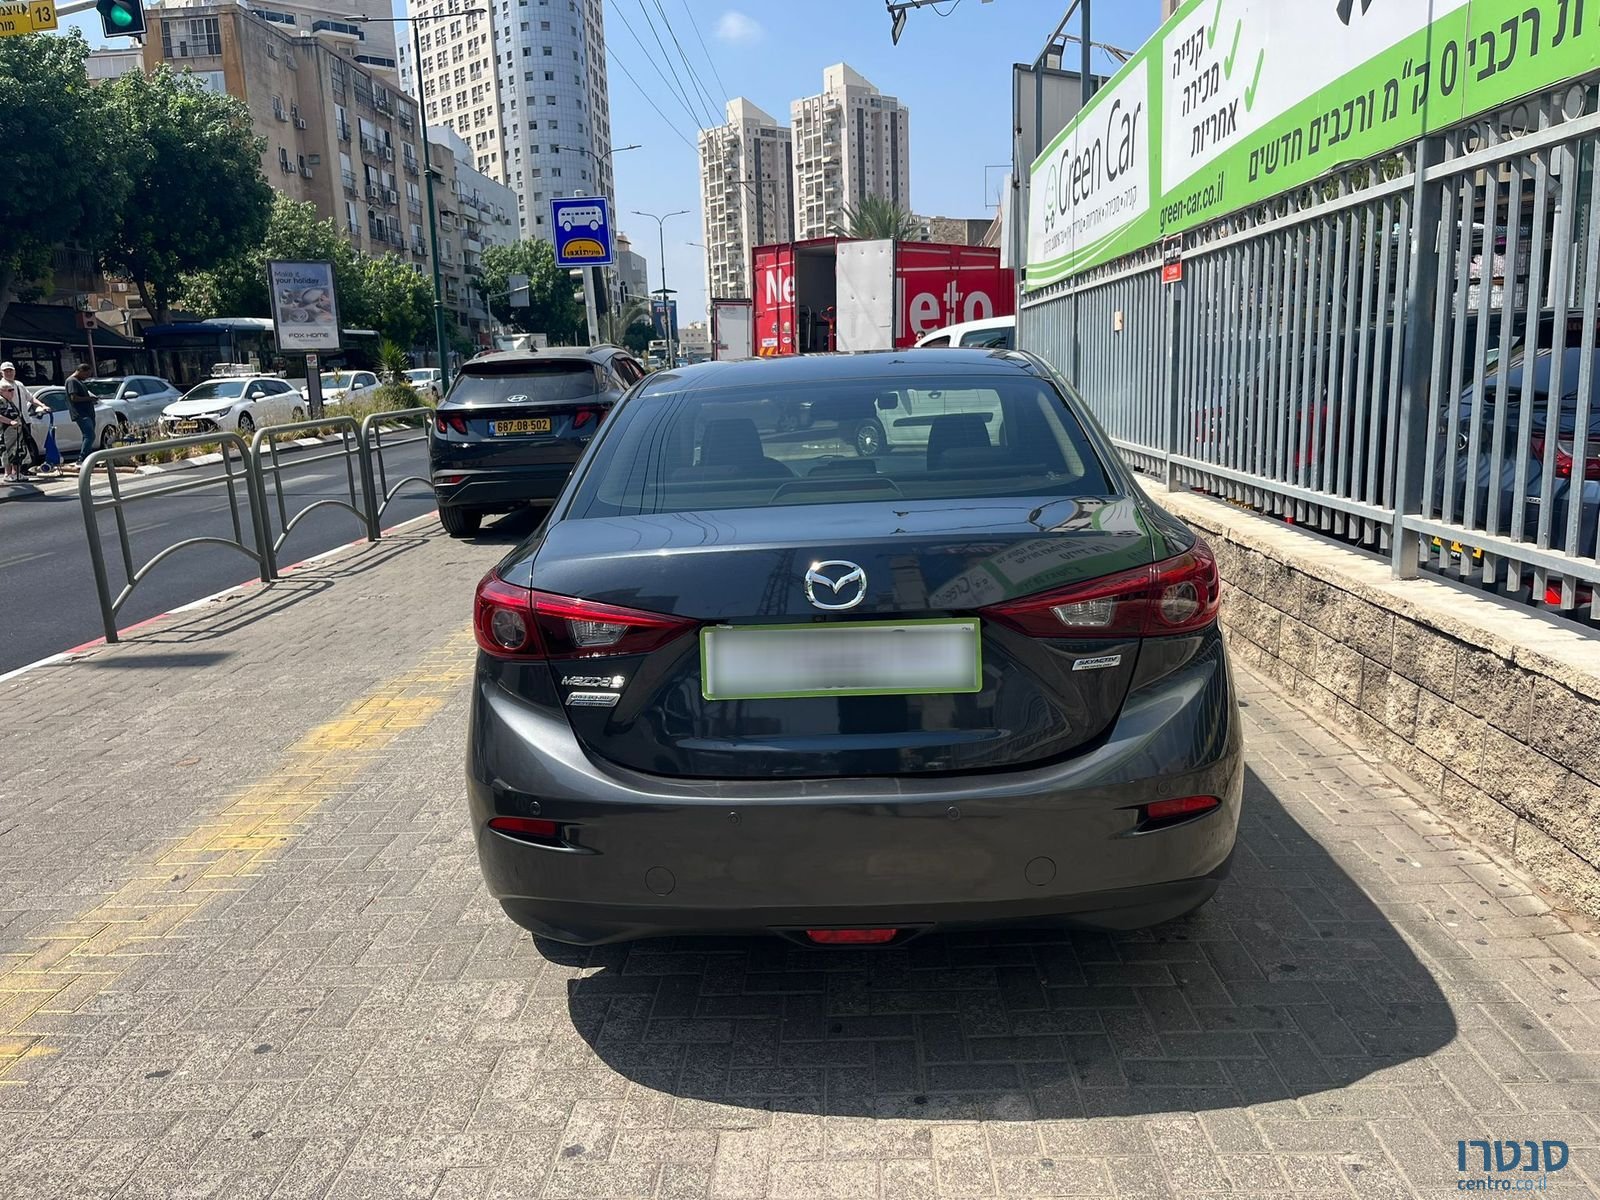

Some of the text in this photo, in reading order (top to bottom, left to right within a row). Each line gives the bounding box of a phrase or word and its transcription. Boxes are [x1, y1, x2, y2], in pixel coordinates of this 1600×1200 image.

[35, 6, 51, 22] 13
[1173, 25, 1204, 79] קנייה
[1182, 62, 1219, 117] מכירה
[1191, 97, 1238, 158] אחריות
[1308, 90, 1375, 156] ורכבים
[1058, 98, 1141, 217] Green Car
[1249, 127, 1302, 183] חדשים
[1159, 172, 1224, 230] green-car.co.il
[293, 277, 319, 285] holiday
